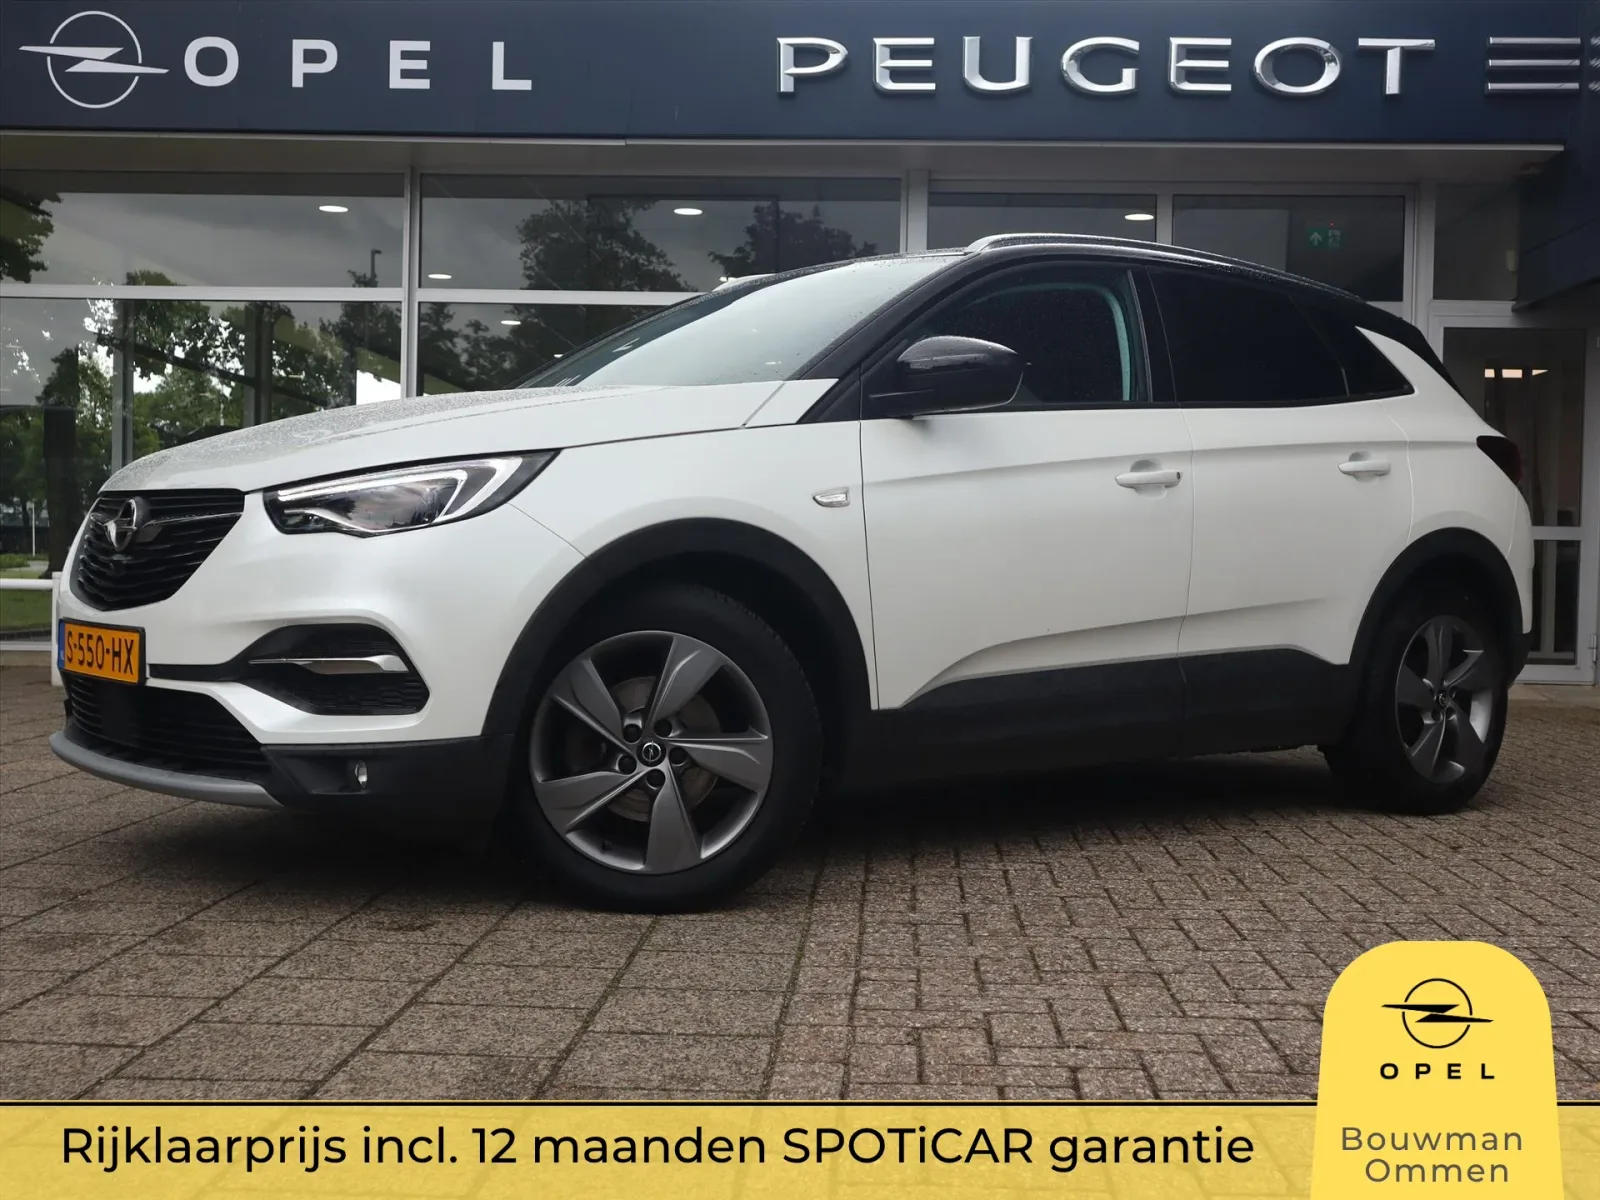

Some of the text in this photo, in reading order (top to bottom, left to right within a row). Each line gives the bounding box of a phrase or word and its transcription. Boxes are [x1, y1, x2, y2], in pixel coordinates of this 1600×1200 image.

[183, 36, 533, 91] OPEL
[775, 36, 1437, 96] PEUGEOT
[66, 630, 135, 676] S-550-HX
